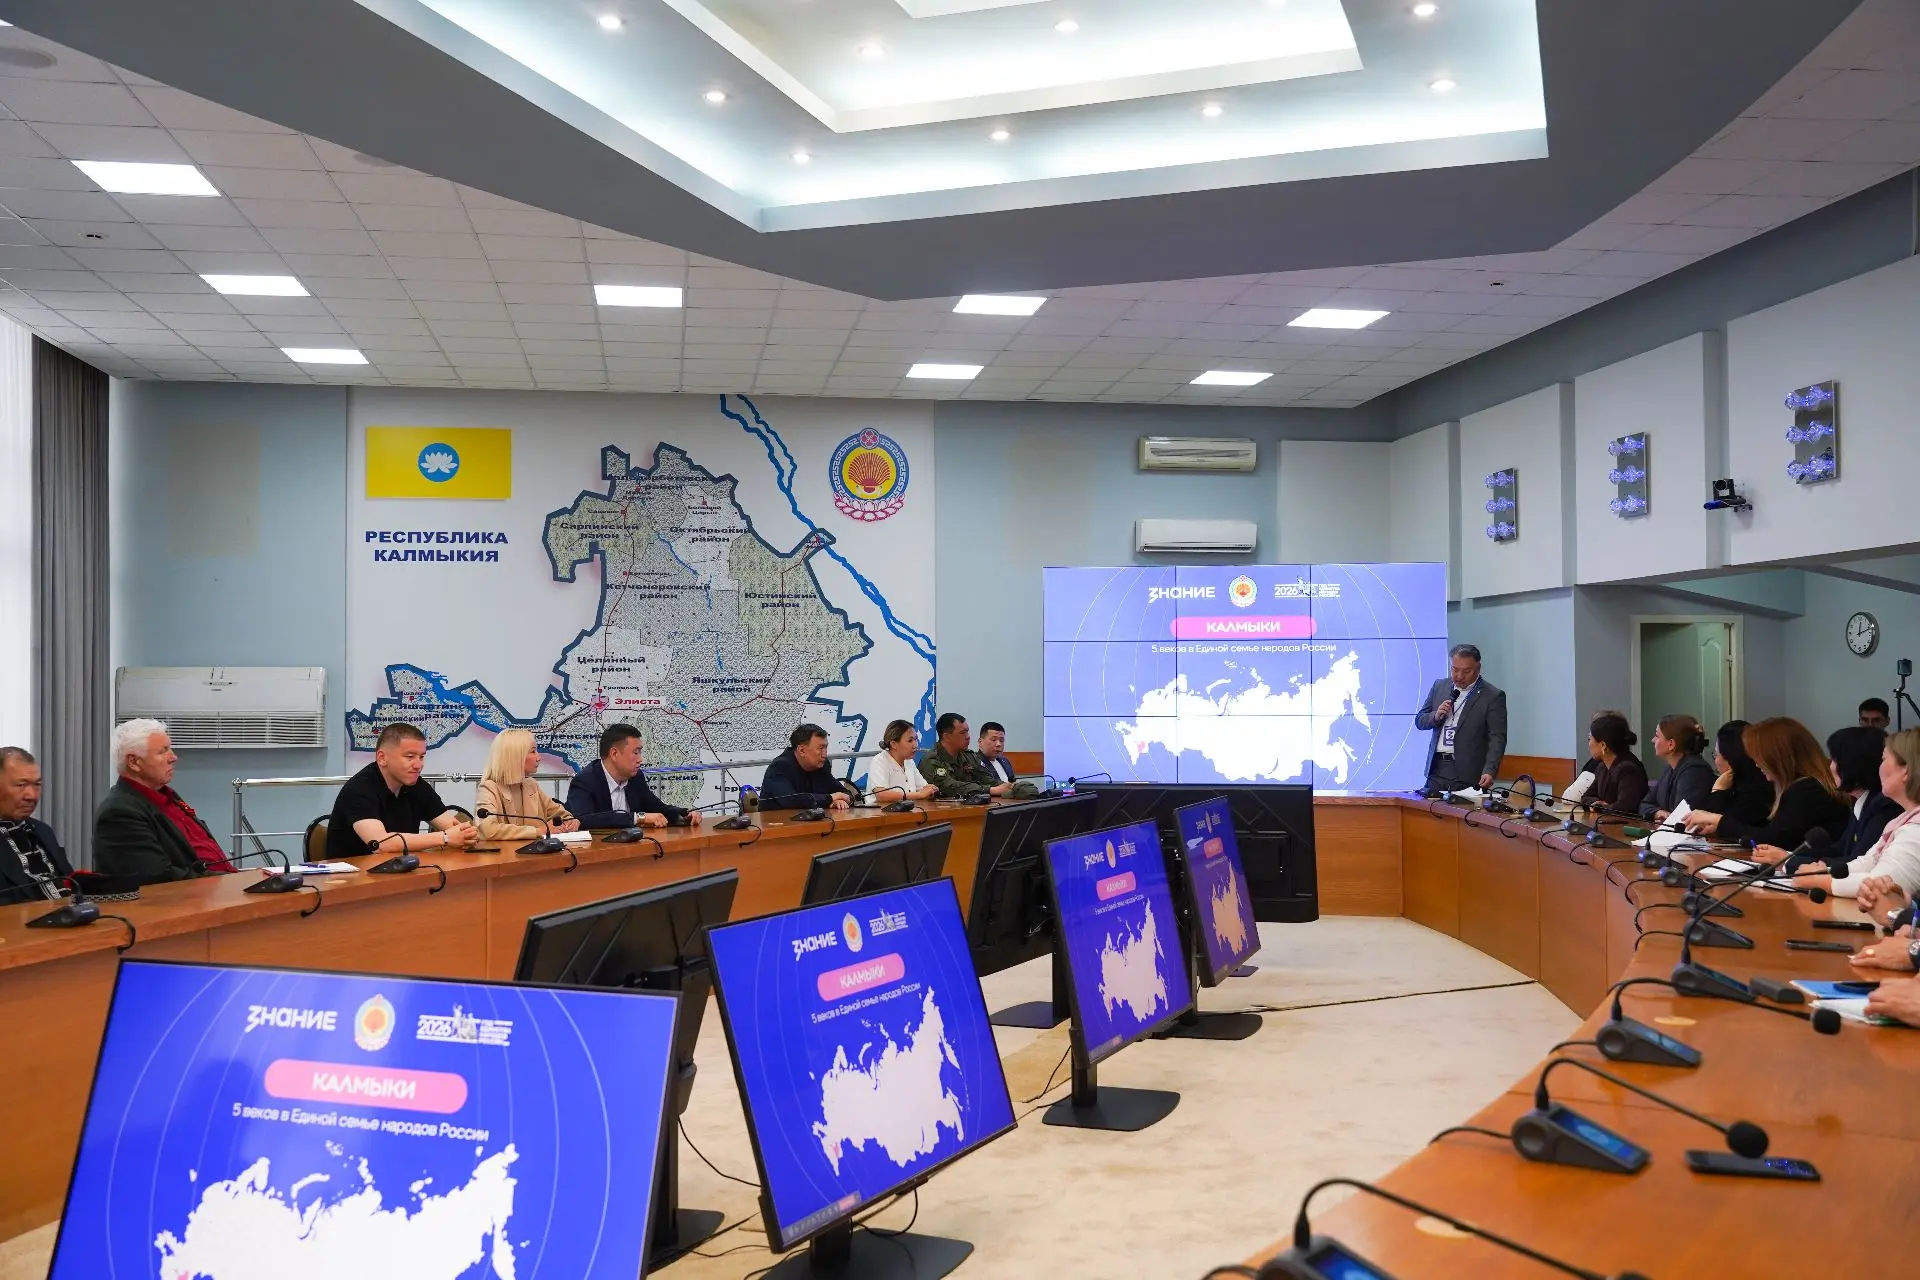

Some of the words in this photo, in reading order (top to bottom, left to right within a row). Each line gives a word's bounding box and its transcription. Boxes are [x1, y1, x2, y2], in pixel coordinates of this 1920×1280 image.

[560, 522, 639, 530] Сарпинский
[365, 531, 509, 544] РЕСПУБЛИКА
[580, 532, 619, 540] район
[691, 535, 730, 543] район
[374, 550, 499, 562] КАЛМЫКИЯ
[1275, 586, 1299, 596] 2026
[640, 592, 678, 600] район
[745, 592, 817, 600] Юстинский
[761, 601, 800, 609] район
[1207, 622, 1281, 633] КАЛМЫКИ
[1152, 645, 1158, 653] 5
[1159, 646, 1187, 654] веков
[1196, 644, 1229, 654] Единой
[1262, 645, 1300, 654] народов
[1302, 643, 1337, 652] России
[577, 656, 646, 664] Целинный
[592, 666, 631, 674] район
[692, 676, 771, 684] Яшкульский
[713, 685, 751, 693] район
[425, 711, 464, 719] район
[839, 964, 885, 989] КАЛМЫКИ
[811, 1012, 818, 1024] 5
[417, 1019, 452, 1037] 2026
[312, 1073, 416, 1100] КАЛМЫКИ
[232, 1102, 242, 1117] 5
[242, 1106, 279, 1121] веков
[281, 1110, 290, 1122] в
[291, 1108, 338, 1126] Единой
[339, 1115, 380, 1130] семье
[381, 1120, 438, 1136] народов
[439, 1122, 489, 1142] России
